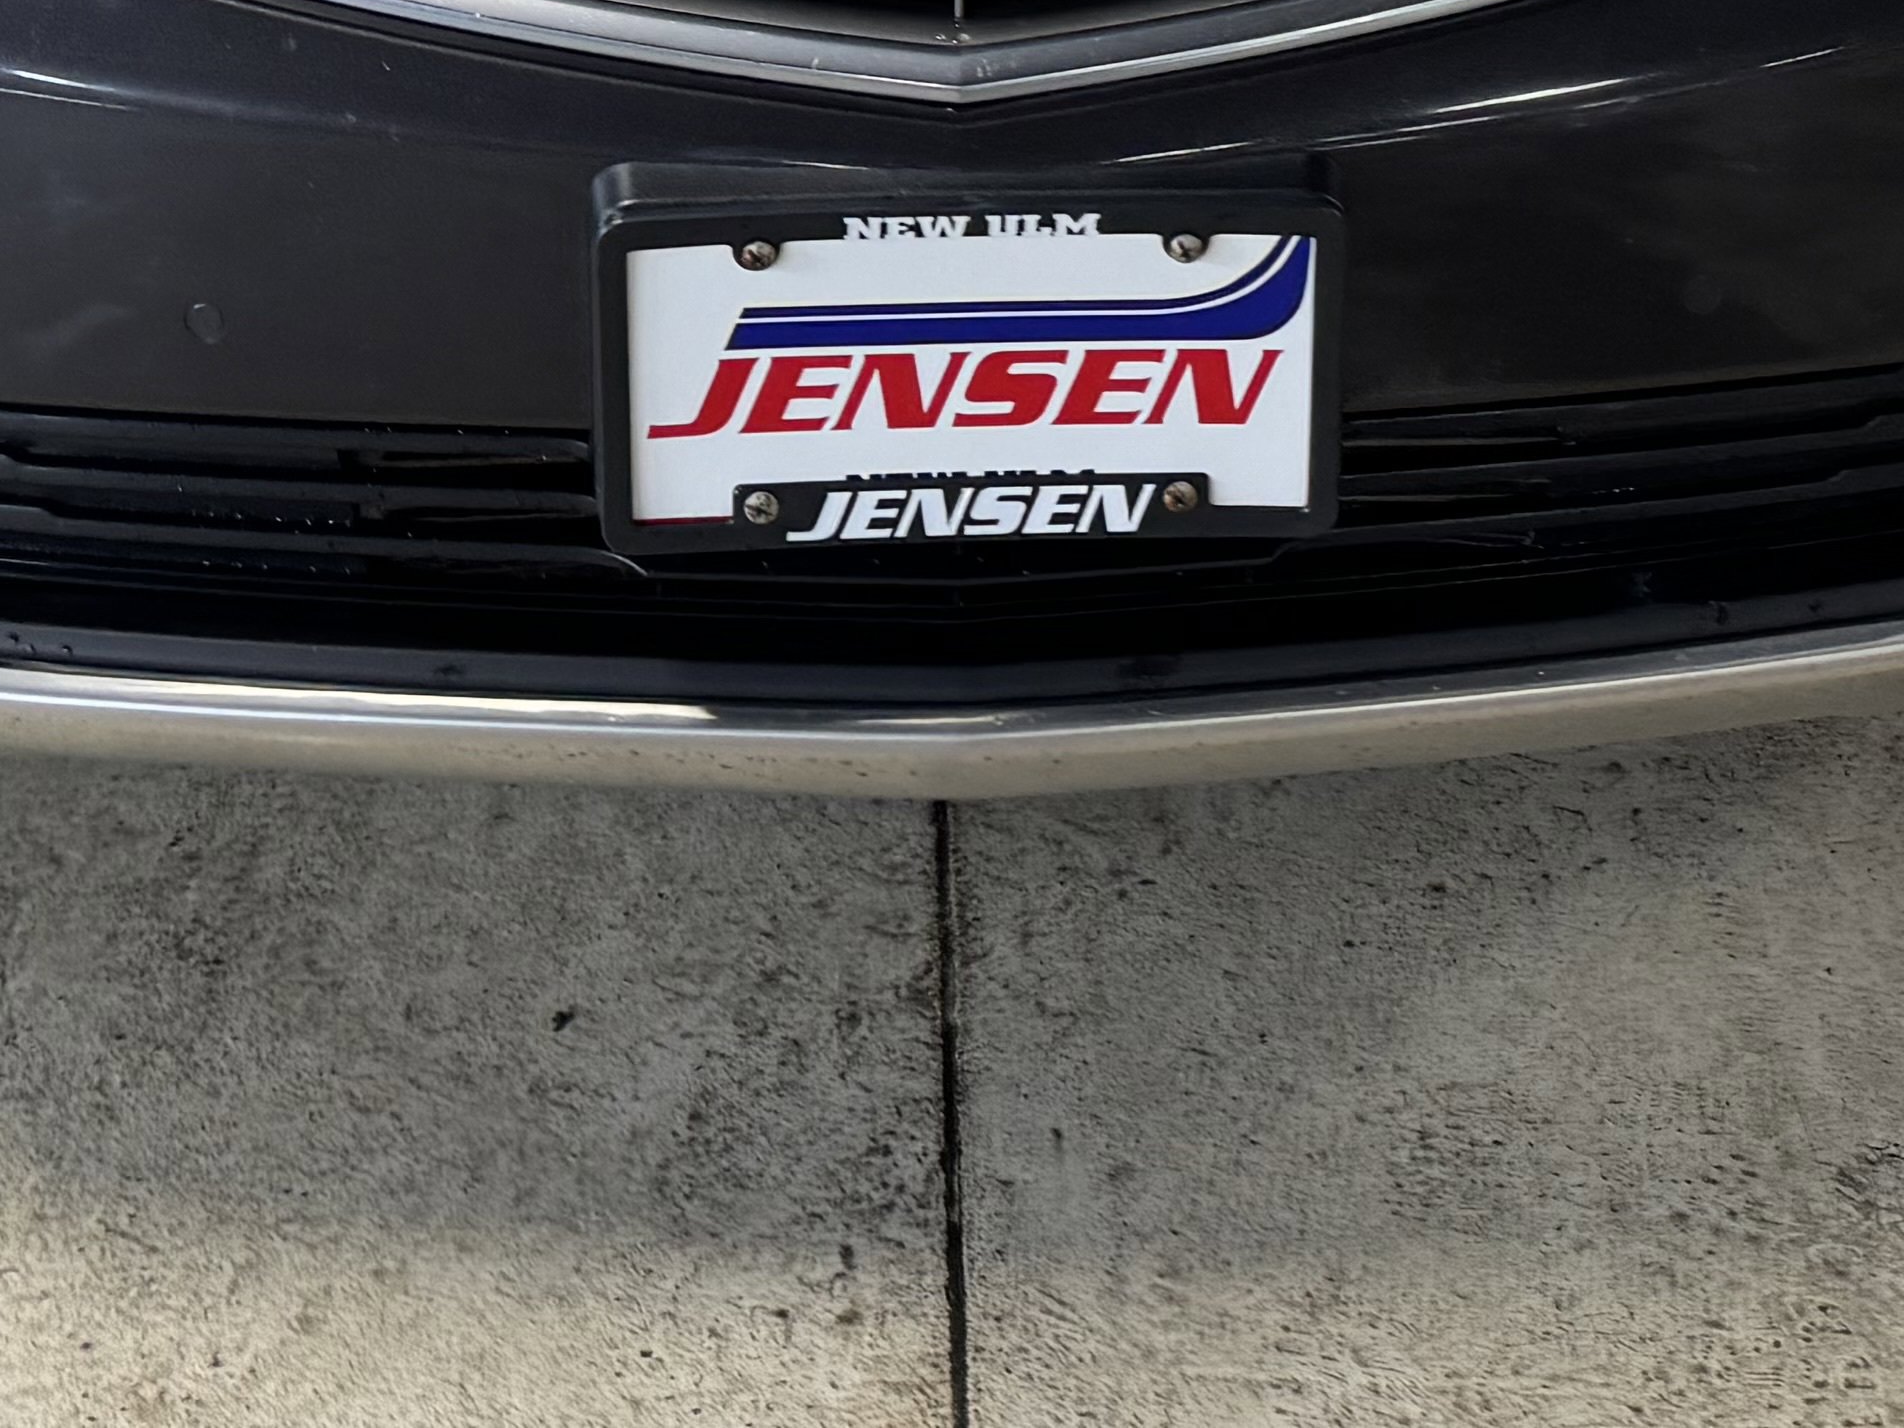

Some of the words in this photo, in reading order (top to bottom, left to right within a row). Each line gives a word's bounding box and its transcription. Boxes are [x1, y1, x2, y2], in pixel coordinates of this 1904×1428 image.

[843, 216, 971, 240] NEW
[985, 213, 1101, 237] ULM
[647, 349, 1284, 439] JENSEN
[786, 483, 1157, 542] JENSEN
